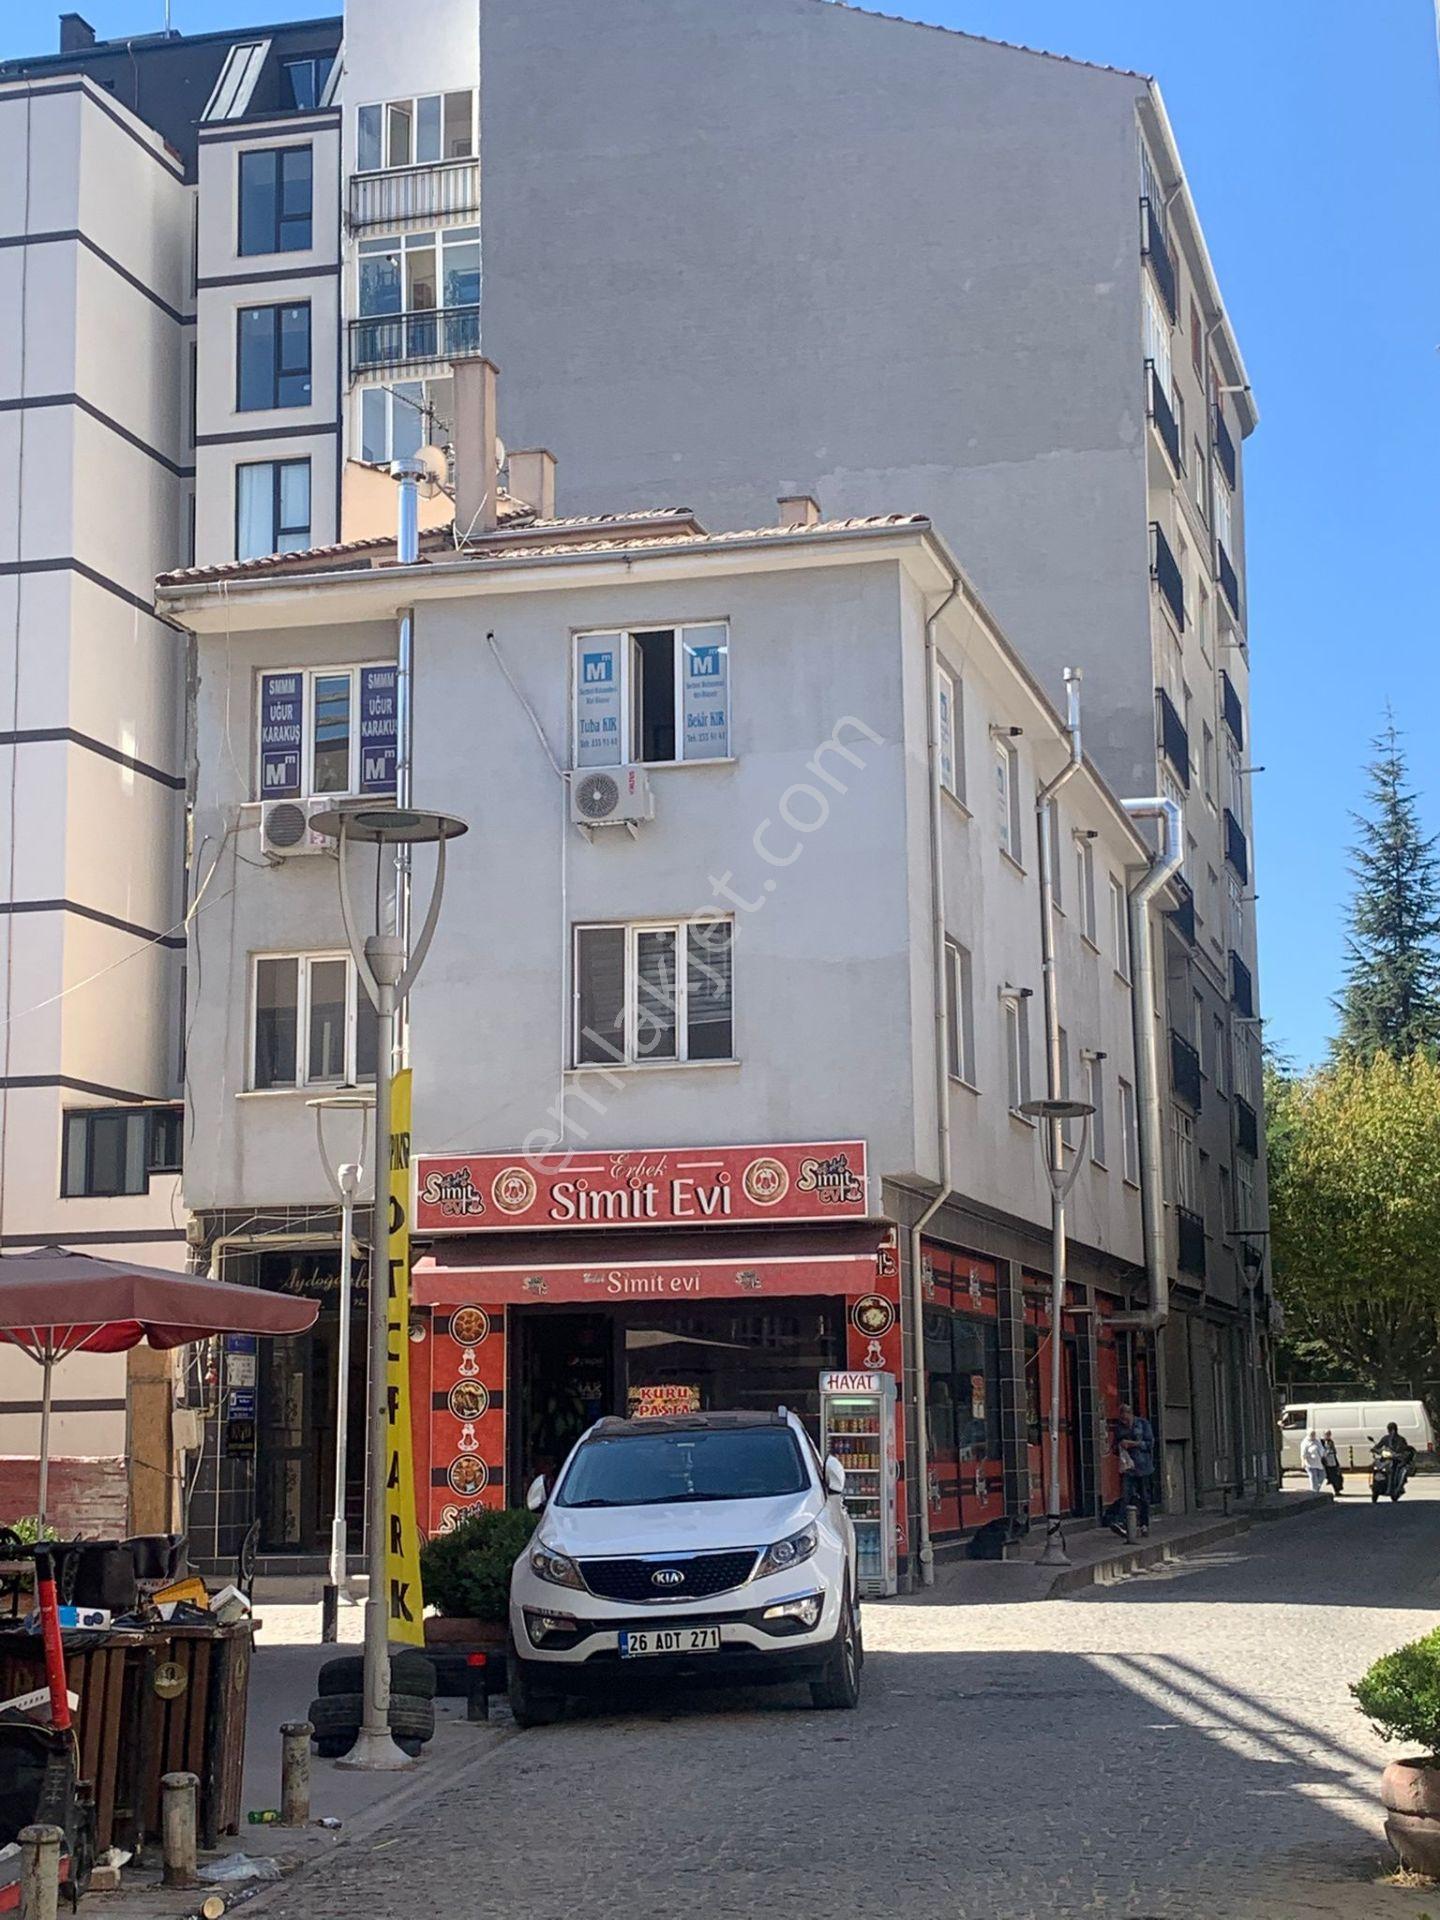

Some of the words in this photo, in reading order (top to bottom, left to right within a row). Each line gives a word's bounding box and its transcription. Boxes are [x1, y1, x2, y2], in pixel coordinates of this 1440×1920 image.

[269, 679, 296, 695] SMMM
[368, 672, 395, 689] SMMM
[270, 702, 293, 721] UĞUR
[369, 697, 393, 715] UĞUR
[262, 725, 300, 745] KARAKUŞ
[580, 719, 600, 733] Tuba
[610, 1153, 668, 1180] Erbek
[797, 1159, 852, 1192] Simit
[422, 1172, 475, 1204] Simit
[551, 1177, 659, 1220] Simit
[673, 1171, 731, 1216] Evi
[607, 1271, 663, 1293] Simit
[670, 1271, 701, 1292] evi
[827, 1375, 875, 1390] HAYAT
[641, 1388, 688, 1399] KURU
[640, 1404, 690, 1416] PASTA
[655, 1573, 678, 1583] KIA
[629, 1634, 648, 1652] 26
[656, 1632, 682, 1650] ADT
[691, 1629, 717, 1648] 271
